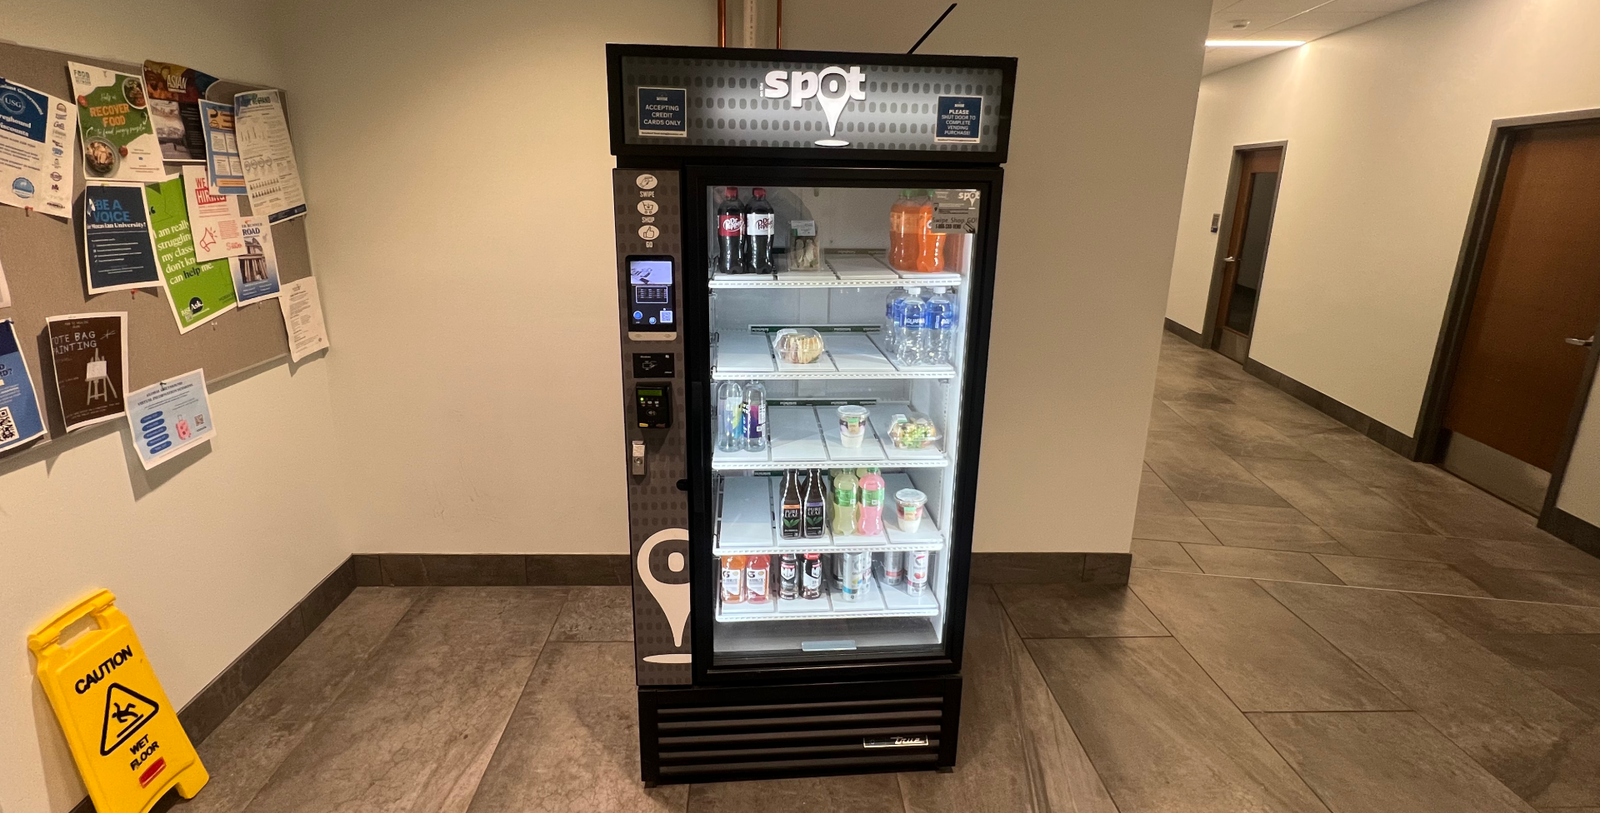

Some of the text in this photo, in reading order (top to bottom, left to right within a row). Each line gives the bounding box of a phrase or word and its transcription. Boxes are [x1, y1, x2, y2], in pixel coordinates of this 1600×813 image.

[166, 74, 187, 90] ASIAN
[765, 66, 866, 108] spot
[4, 97, 22, 108] USG
[645, 104, 679, 112] ACCEPTING
[90, 103, 130, 117] RECOVER
[102, 115, 126, 127] FOOD
[195, 177, 206, 188] WE
[639, 190, 655, 198] SWIPE
[95, 199, 123, 211] BE A
[93, 210, 131, 222] VOICE
[158, 226, 171, 238] am
[242, 226, 261, 237] ROAD
[157, 232, 192, 251] strugglin
[161, 251, 174, 263] my
[165, 256, 197, 274] don't kn
[169, 273, 184, 285] can
[183, 266, 201, 279] help
[74, 331, 96, 341] BAG
[74, 645, 133, 694] CAUTION
[129, 733, 150, 755] WET
[129, 740, 160, 771] FLOOR
